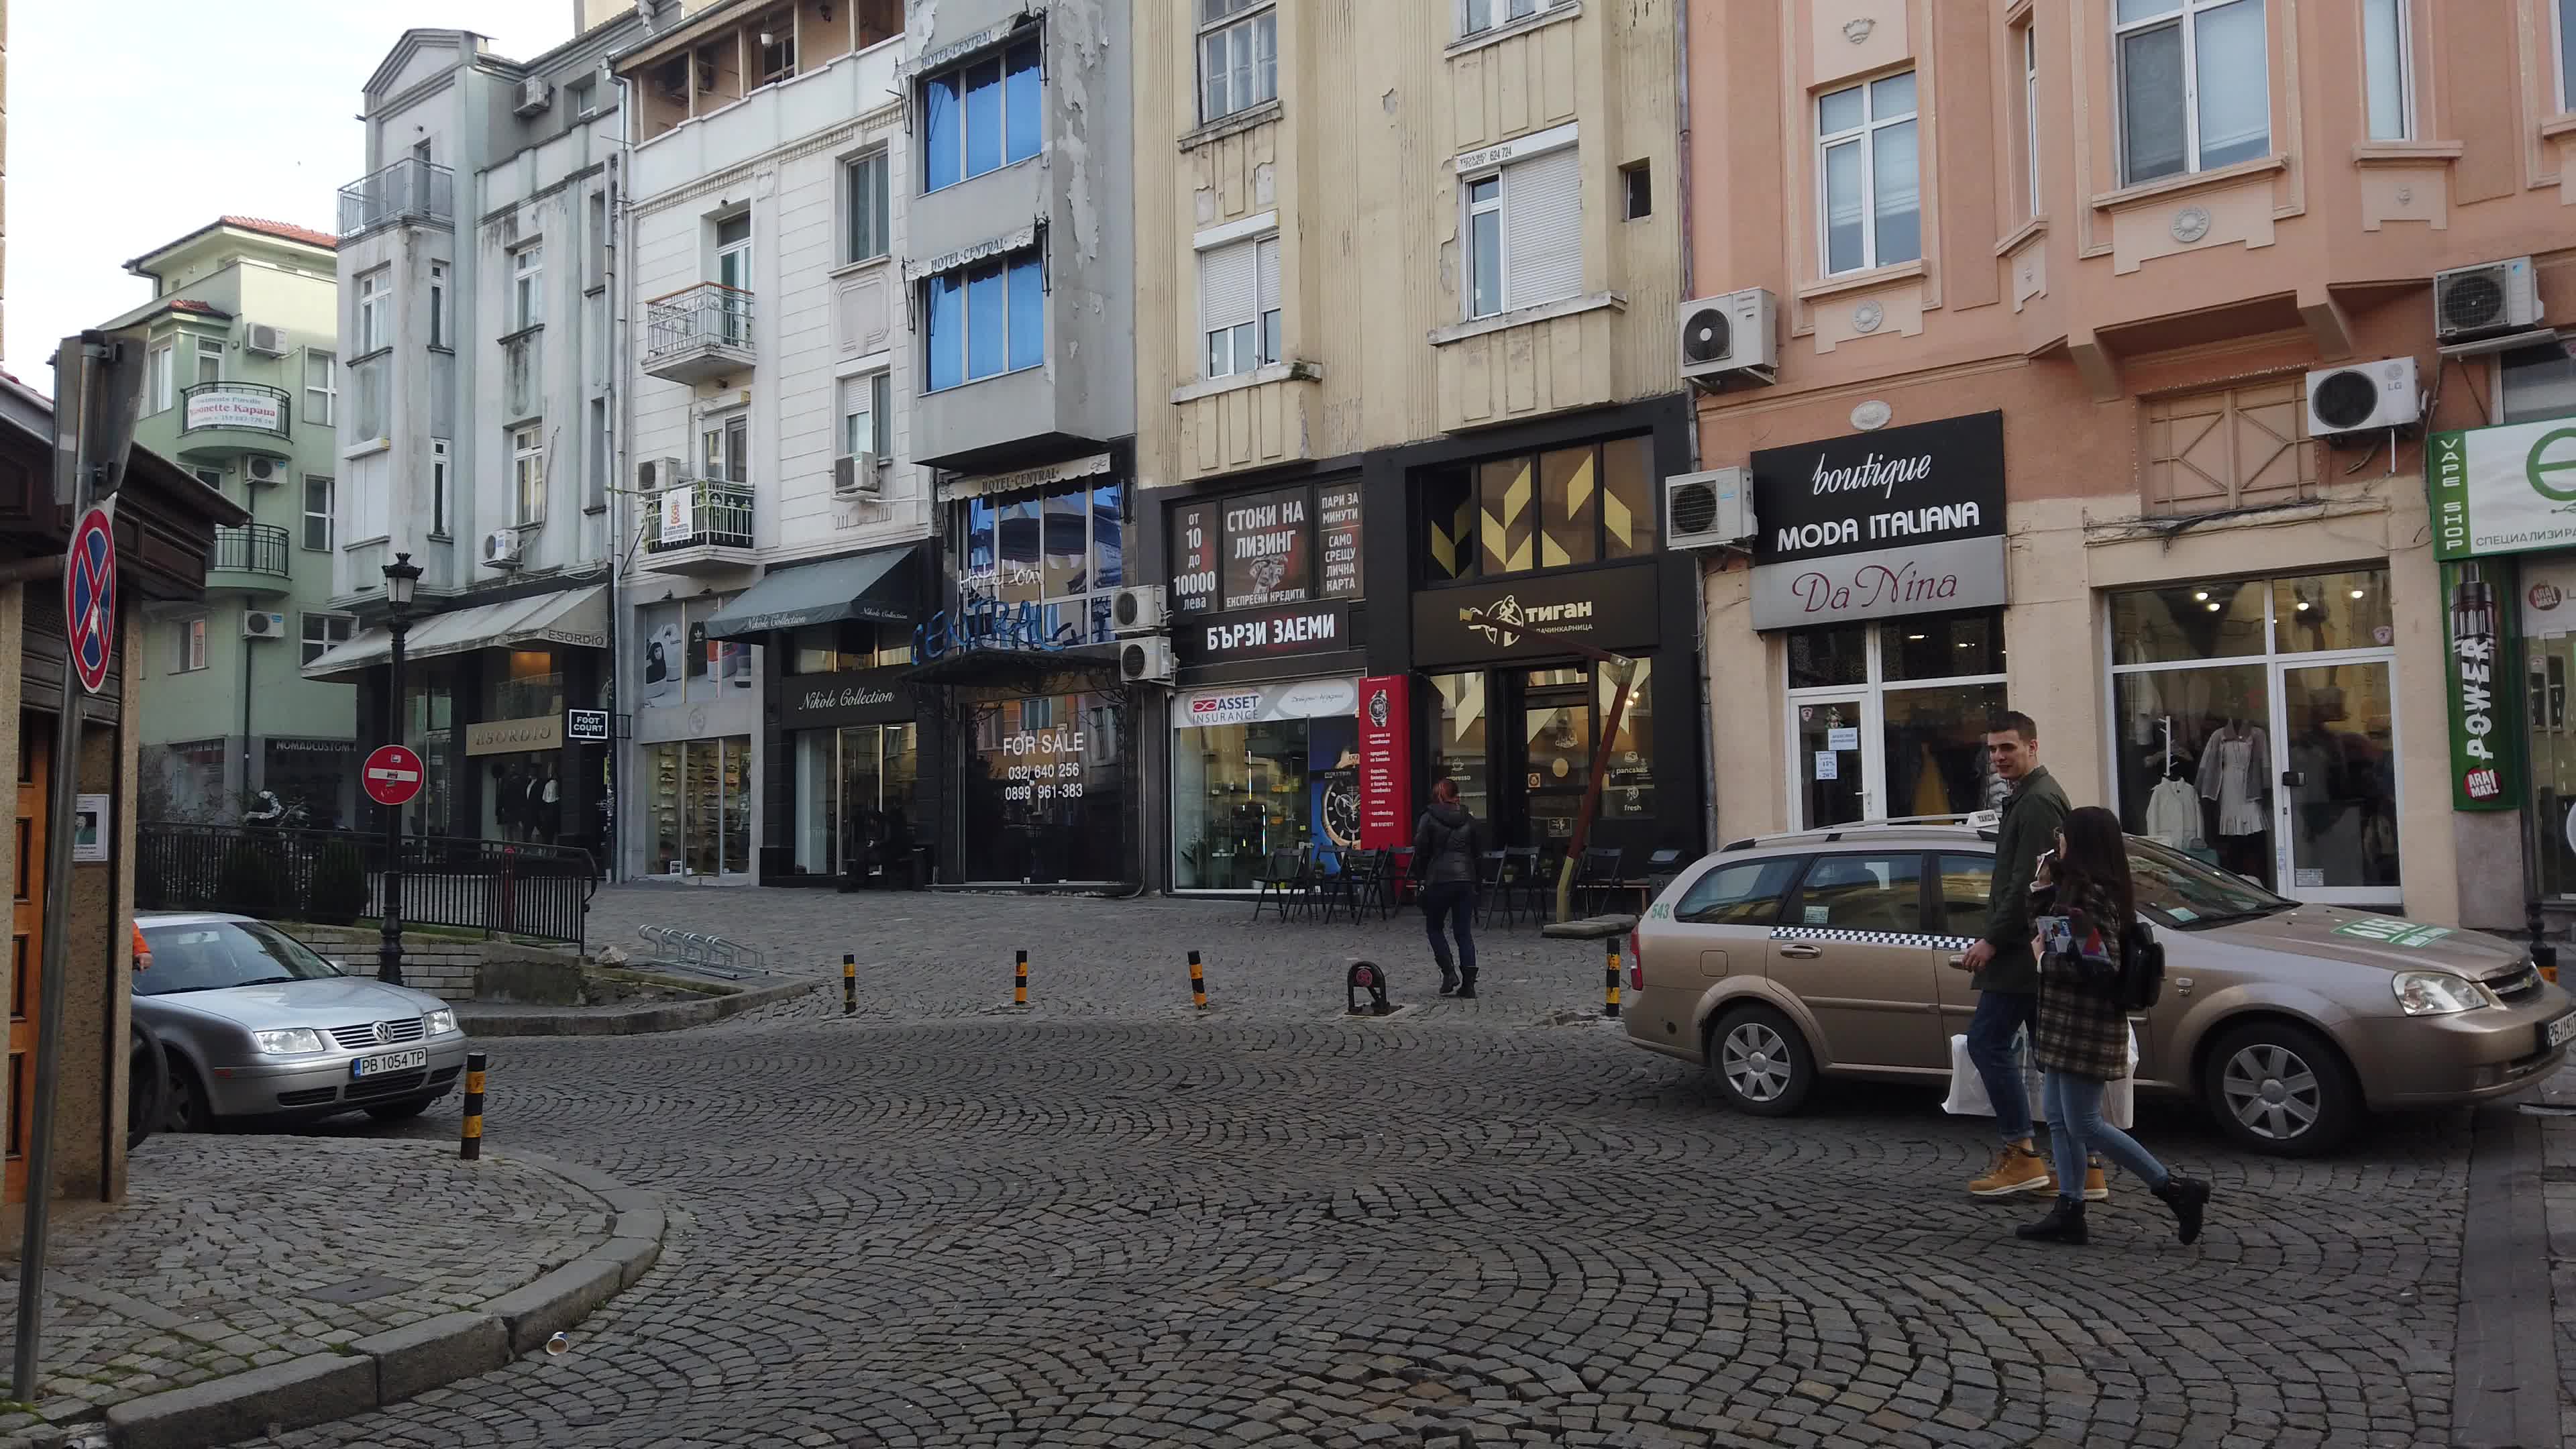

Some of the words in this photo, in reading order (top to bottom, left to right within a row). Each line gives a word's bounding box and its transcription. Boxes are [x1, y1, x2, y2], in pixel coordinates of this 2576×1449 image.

[930, 250, 961, 270] HOTEL
[964, 237, 1006, 260] CENTRAL
[2440, 438, 2460, 487] VAPE
[982, 477, 1012, 492] HOTEL
[1015, 468, 1057, 486] CENTRAL
[1812, 452, 1931, 498] boutique
[1322, 495, 1345, 509] ПАРИ
[1347, 492, 1359, 505] ЗА
[1227, 504, 1277, 532] СТОКИ
[1283, 500, 1304, 524] НА
[1322, 508, 1358, 524] МИНУТИ
[1778, 518, 1859, 551] MODA
[1870, 501, 1980, 539] ITALIANA
[2444, 501, 2463, 550] SHOP
[1186, 528, 1201, 549] 10
[1235, 529, 1296, 559] ЛИЗИНГ
[1329, 533, 1352, 547] САМО
[1325, 547, 1356, 563] СРЕЩУ
[1326, 563, 1355, 578] ЛИЧНА
[1174, 571, 1216, 596] 10000
[1326, 578, 1355, 592] КАРТА
[1792, 572, 1850, 612] Da
[1855, 561, 1957, 607] Nina
[1183, 596, 1206, 610] лева
[1226, 593, 1268, 608] ЕКСПРЕСНИ
[1270, 588, 1305, 602] КРЕДИТИ
[548, 630, 604, 646] ESORDIO
[1207, 621, 1267, 650] БЪРЗИ
[1273, 613, 1334, 644] ЗАЕМИ
[841, 686, 896, 707] Collection
[1218, 695, 1259, 711] ASSET
[2461, 637, 2493, 761] POWER
[576, 716, 600, 724] FOOT
[1192, 709, 1258, 725] INSURANCE
[475, 725, 551, 746] ESORDIO
[574, 723, 603, 732] COURT
[1004, 736, 1036, 756] FOR
[1041, 733, 1083, 754] SALE
[1008, 765, 1031, 781] 032/
[1034, 764, 1055, 778] 640
[1059, 763, 1079, 777] 256
[2469, 770, 2491, 787] ARA
[1005, 786, 1031, 800] 0899
[1038, 783, 1083, 799] 961-383
[1652, 904, 1670, 919] 543
[363, 1058, 378, 1073] PB
[382, 1053, 408, 1070] 1054
[410, 1051, 424, 1065] TP
